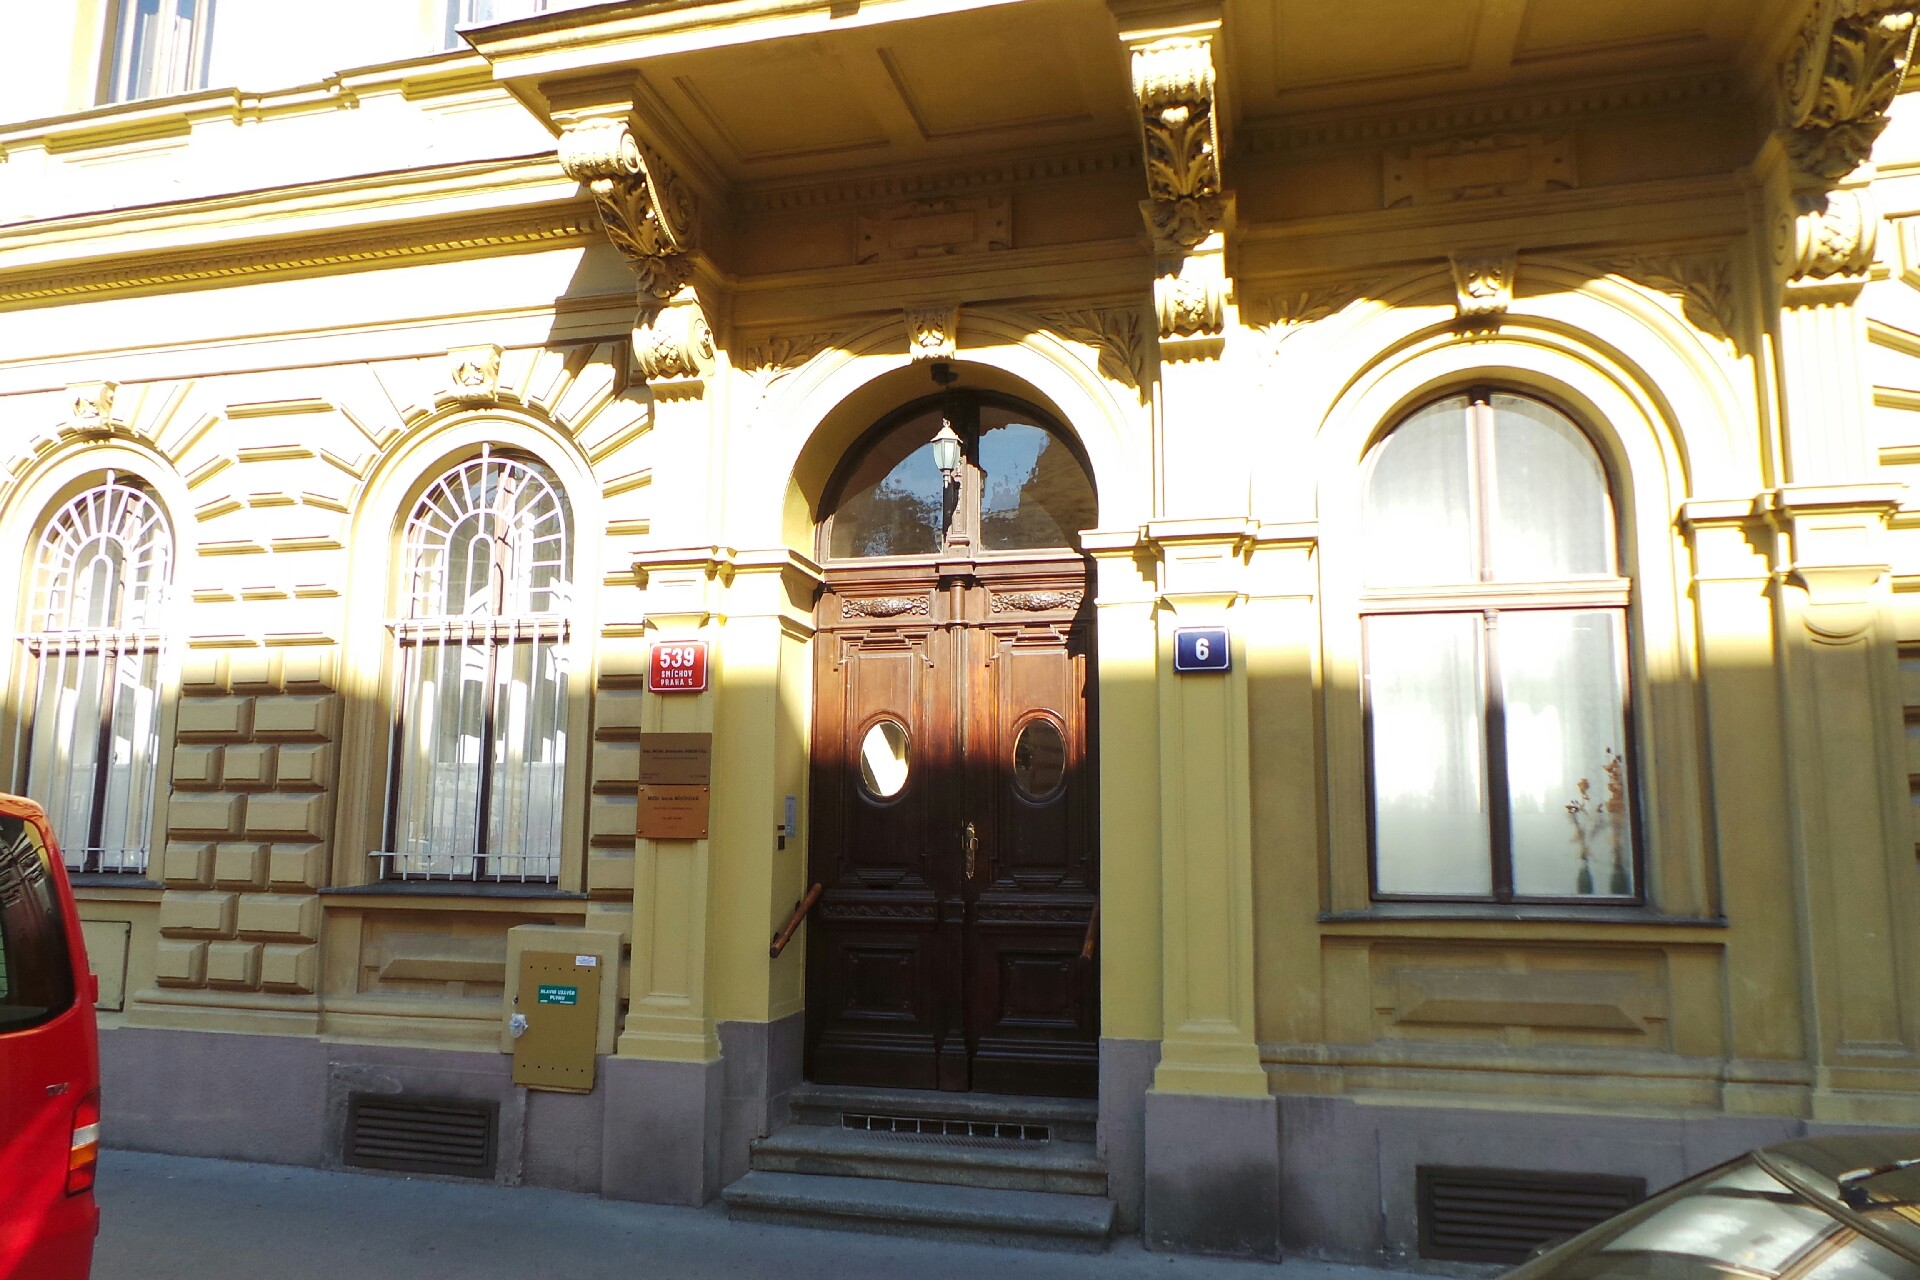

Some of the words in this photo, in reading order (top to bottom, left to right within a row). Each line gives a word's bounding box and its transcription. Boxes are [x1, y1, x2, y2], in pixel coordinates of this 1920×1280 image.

[1195, 637, 1209, 660] 6
[660, 647, 695, 668] 539
[661, 669, 693, 678] SMÍCHOV
[688, 678, 693, 686] 5
